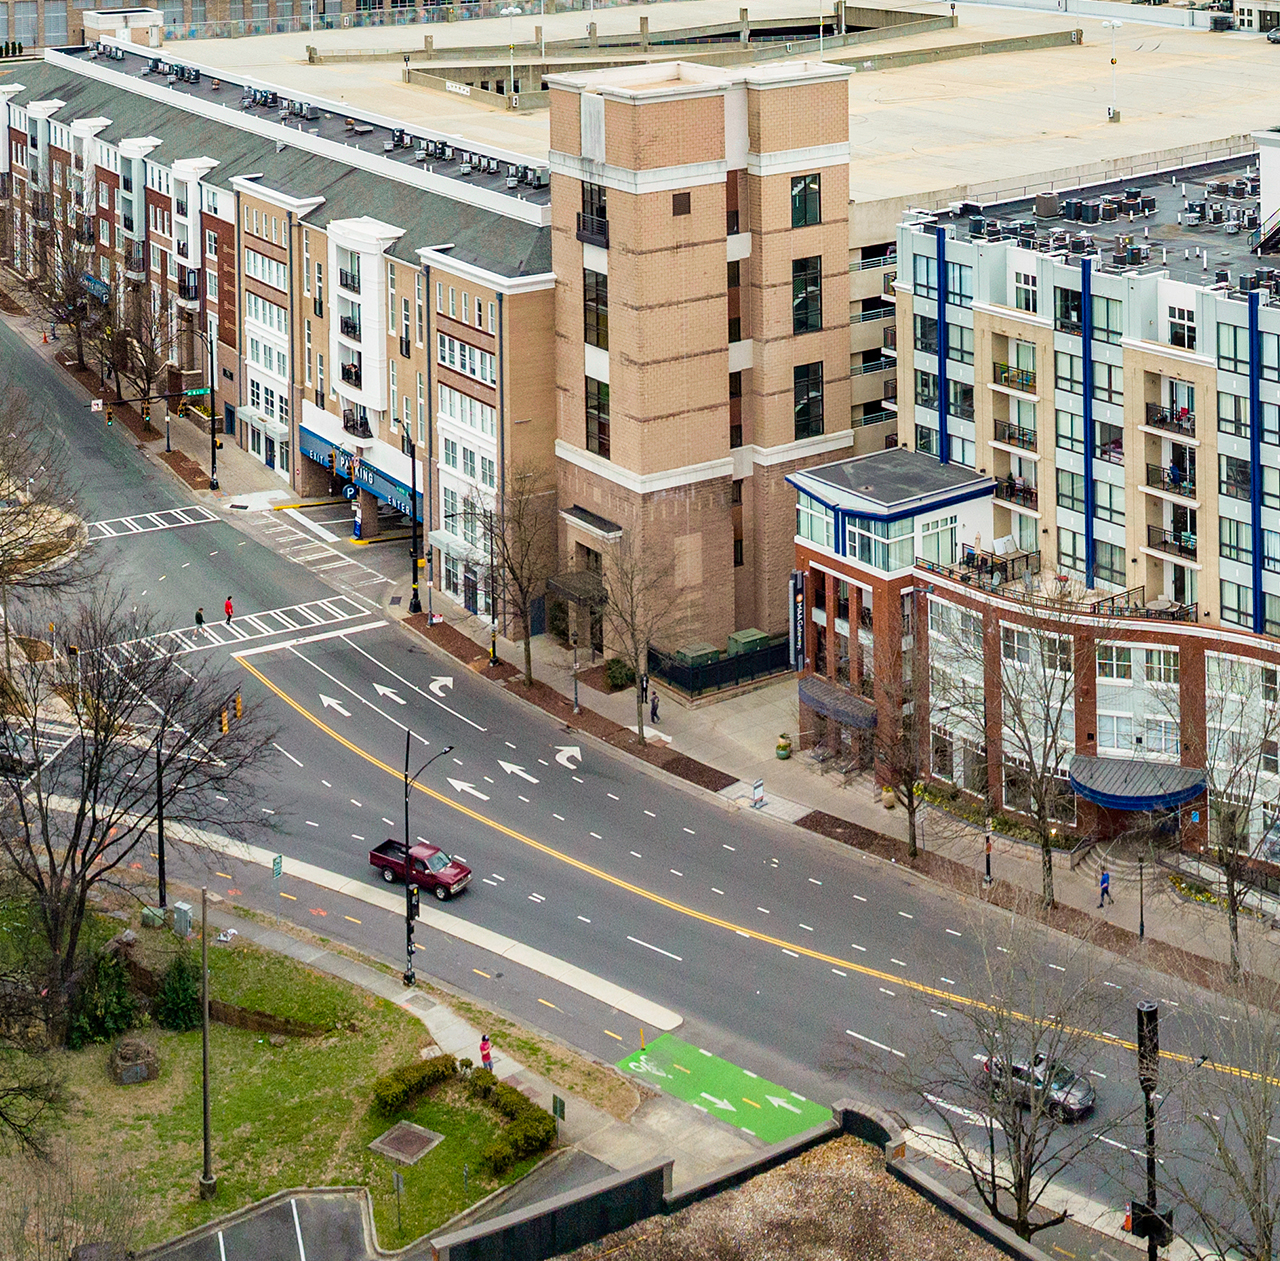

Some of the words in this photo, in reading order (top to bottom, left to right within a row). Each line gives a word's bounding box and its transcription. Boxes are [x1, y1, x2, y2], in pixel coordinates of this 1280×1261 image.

[102, 294, 109, 303] P
[309, 450, 324, 464] EXIT
[340, 456, 375, 485] PAKING
[347, 487, 355, 498] P
[387, 495, 411, 516] ENTER
[796, 602, 804, 620] MAA
